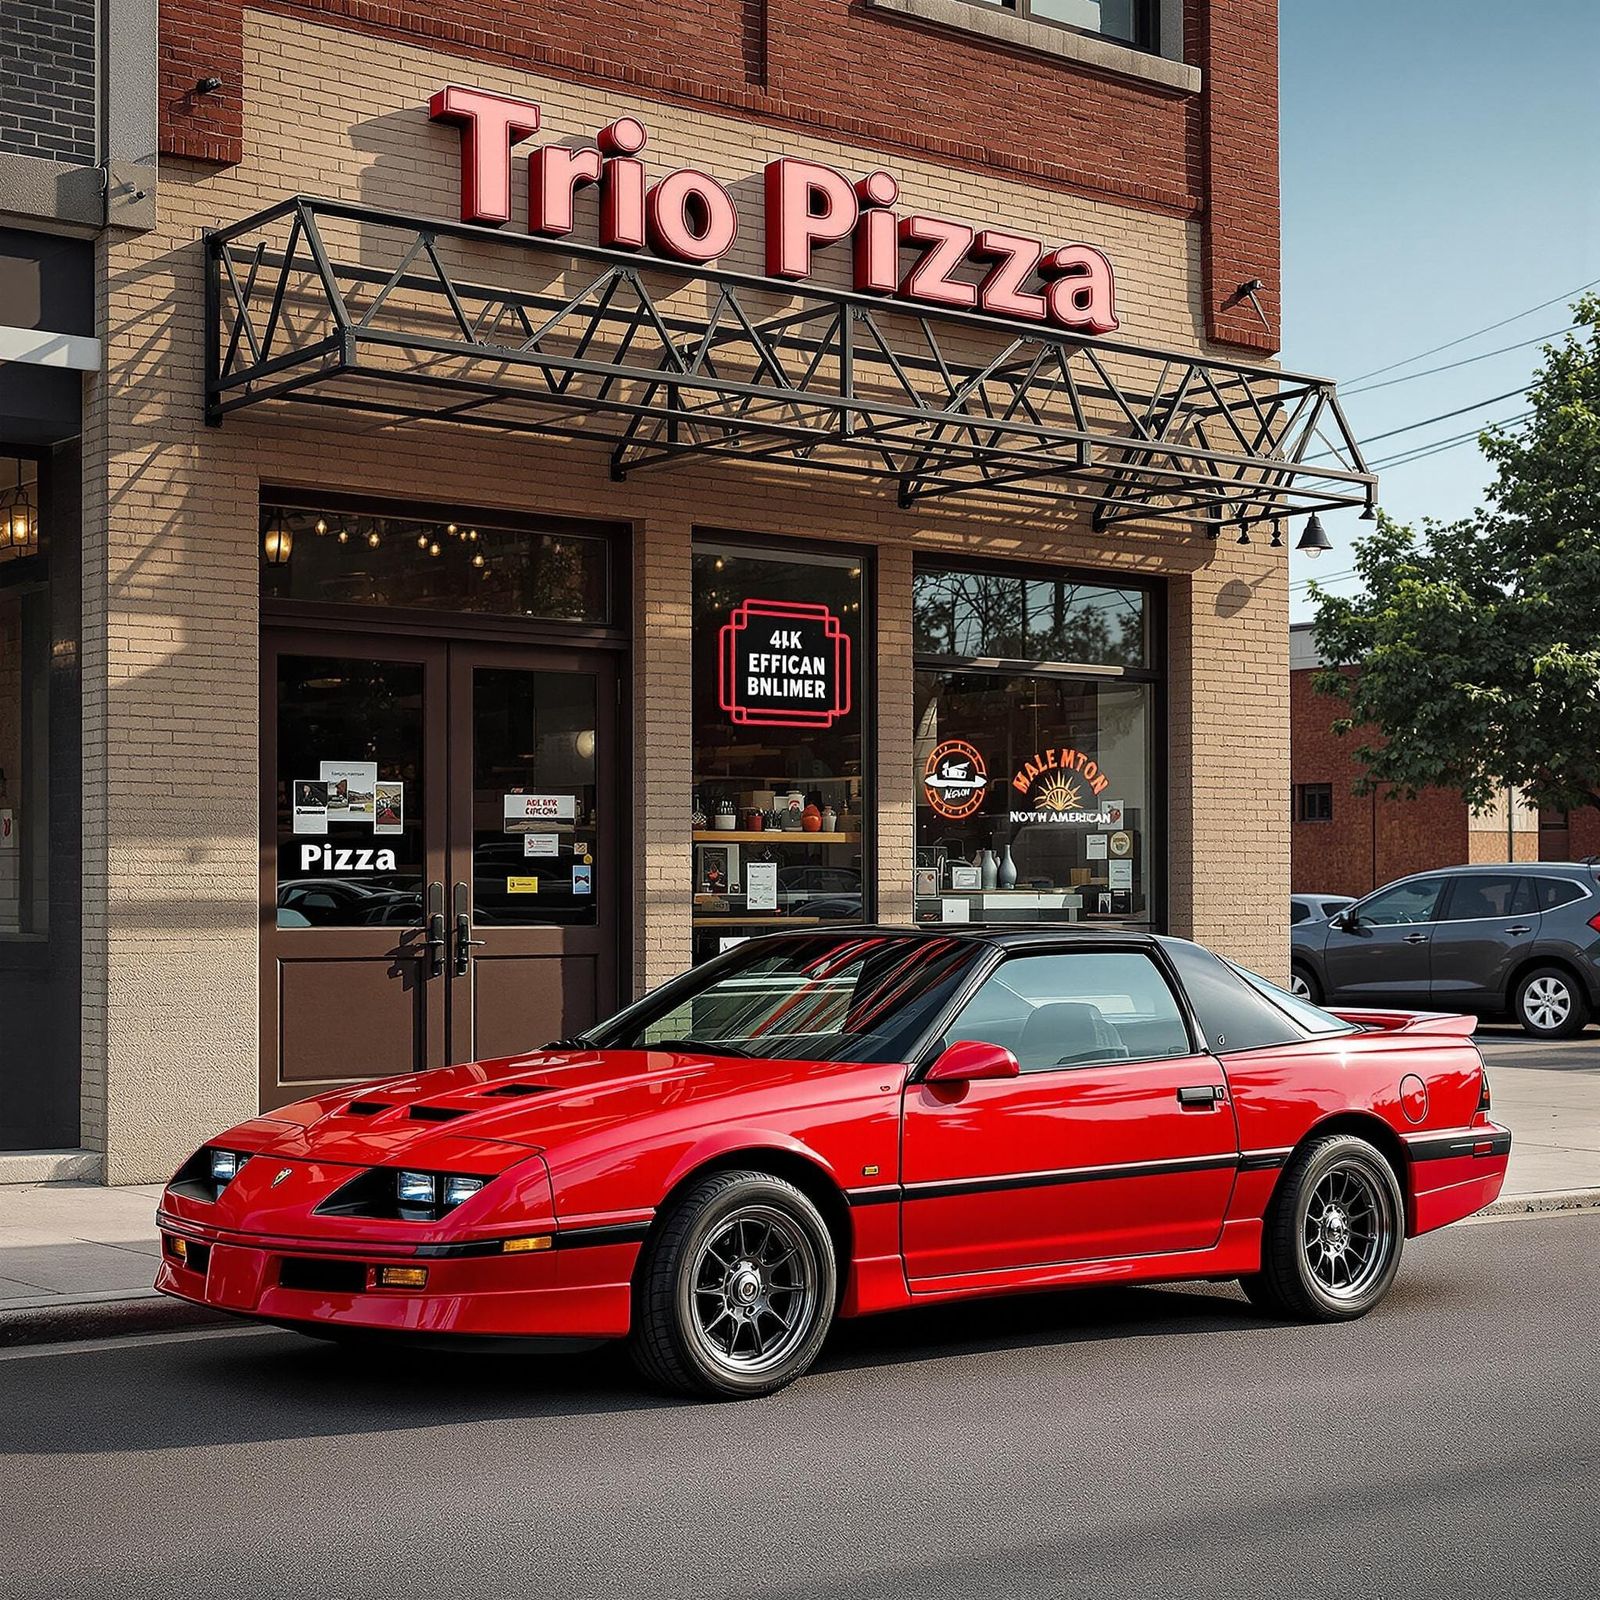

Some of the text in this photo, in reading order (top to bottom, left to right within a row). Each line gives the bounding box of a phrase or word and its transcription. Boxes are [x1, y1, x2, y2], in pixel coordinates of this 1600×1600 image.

[429, 85, 1120, 334] Trio Pizza
[748, 653, 826, 675] EFFICAN
[747, 676, 826, 699] BNLIMER
[301, 843, 397, 870] Pizza
